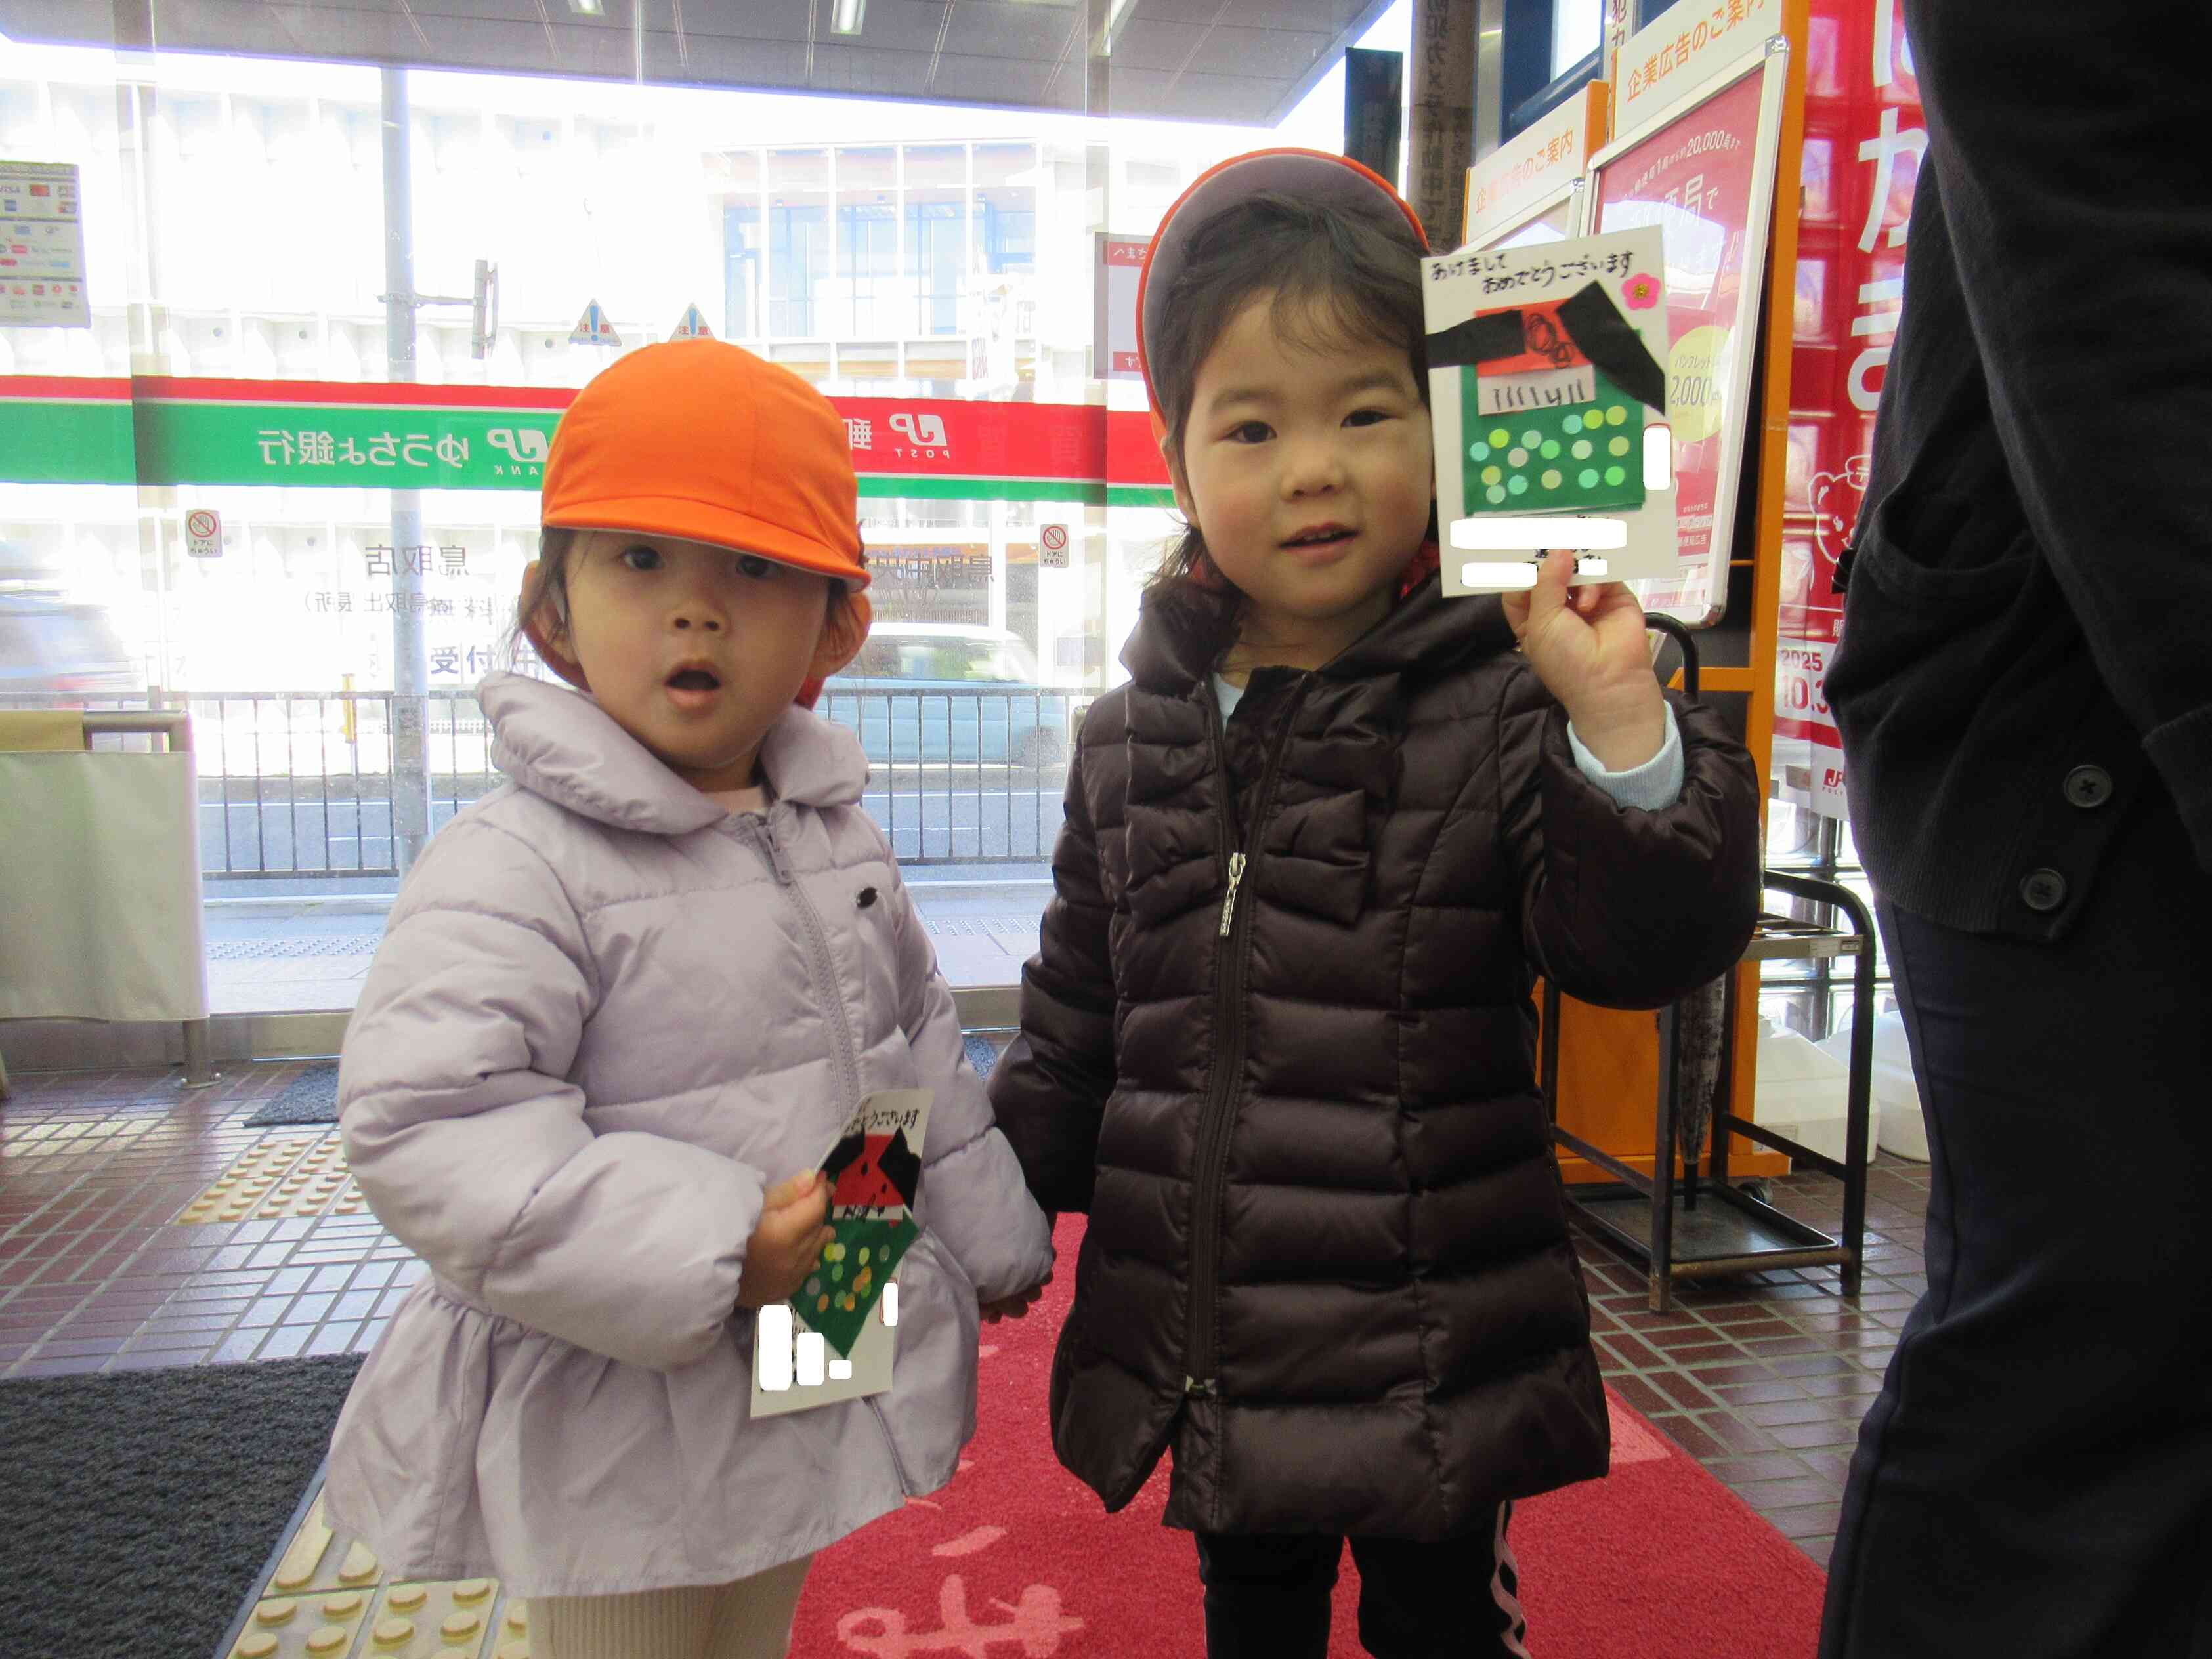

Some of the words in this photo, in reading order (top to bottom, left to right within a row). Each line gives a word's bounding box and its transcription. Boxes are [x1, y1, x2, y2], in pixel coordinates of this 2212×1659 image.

[1432, 253, 1506, 281] あけまして
[1482, 251, 1634, 294] おめでとうございます
[1781, 649, 1823, 672] 2025
